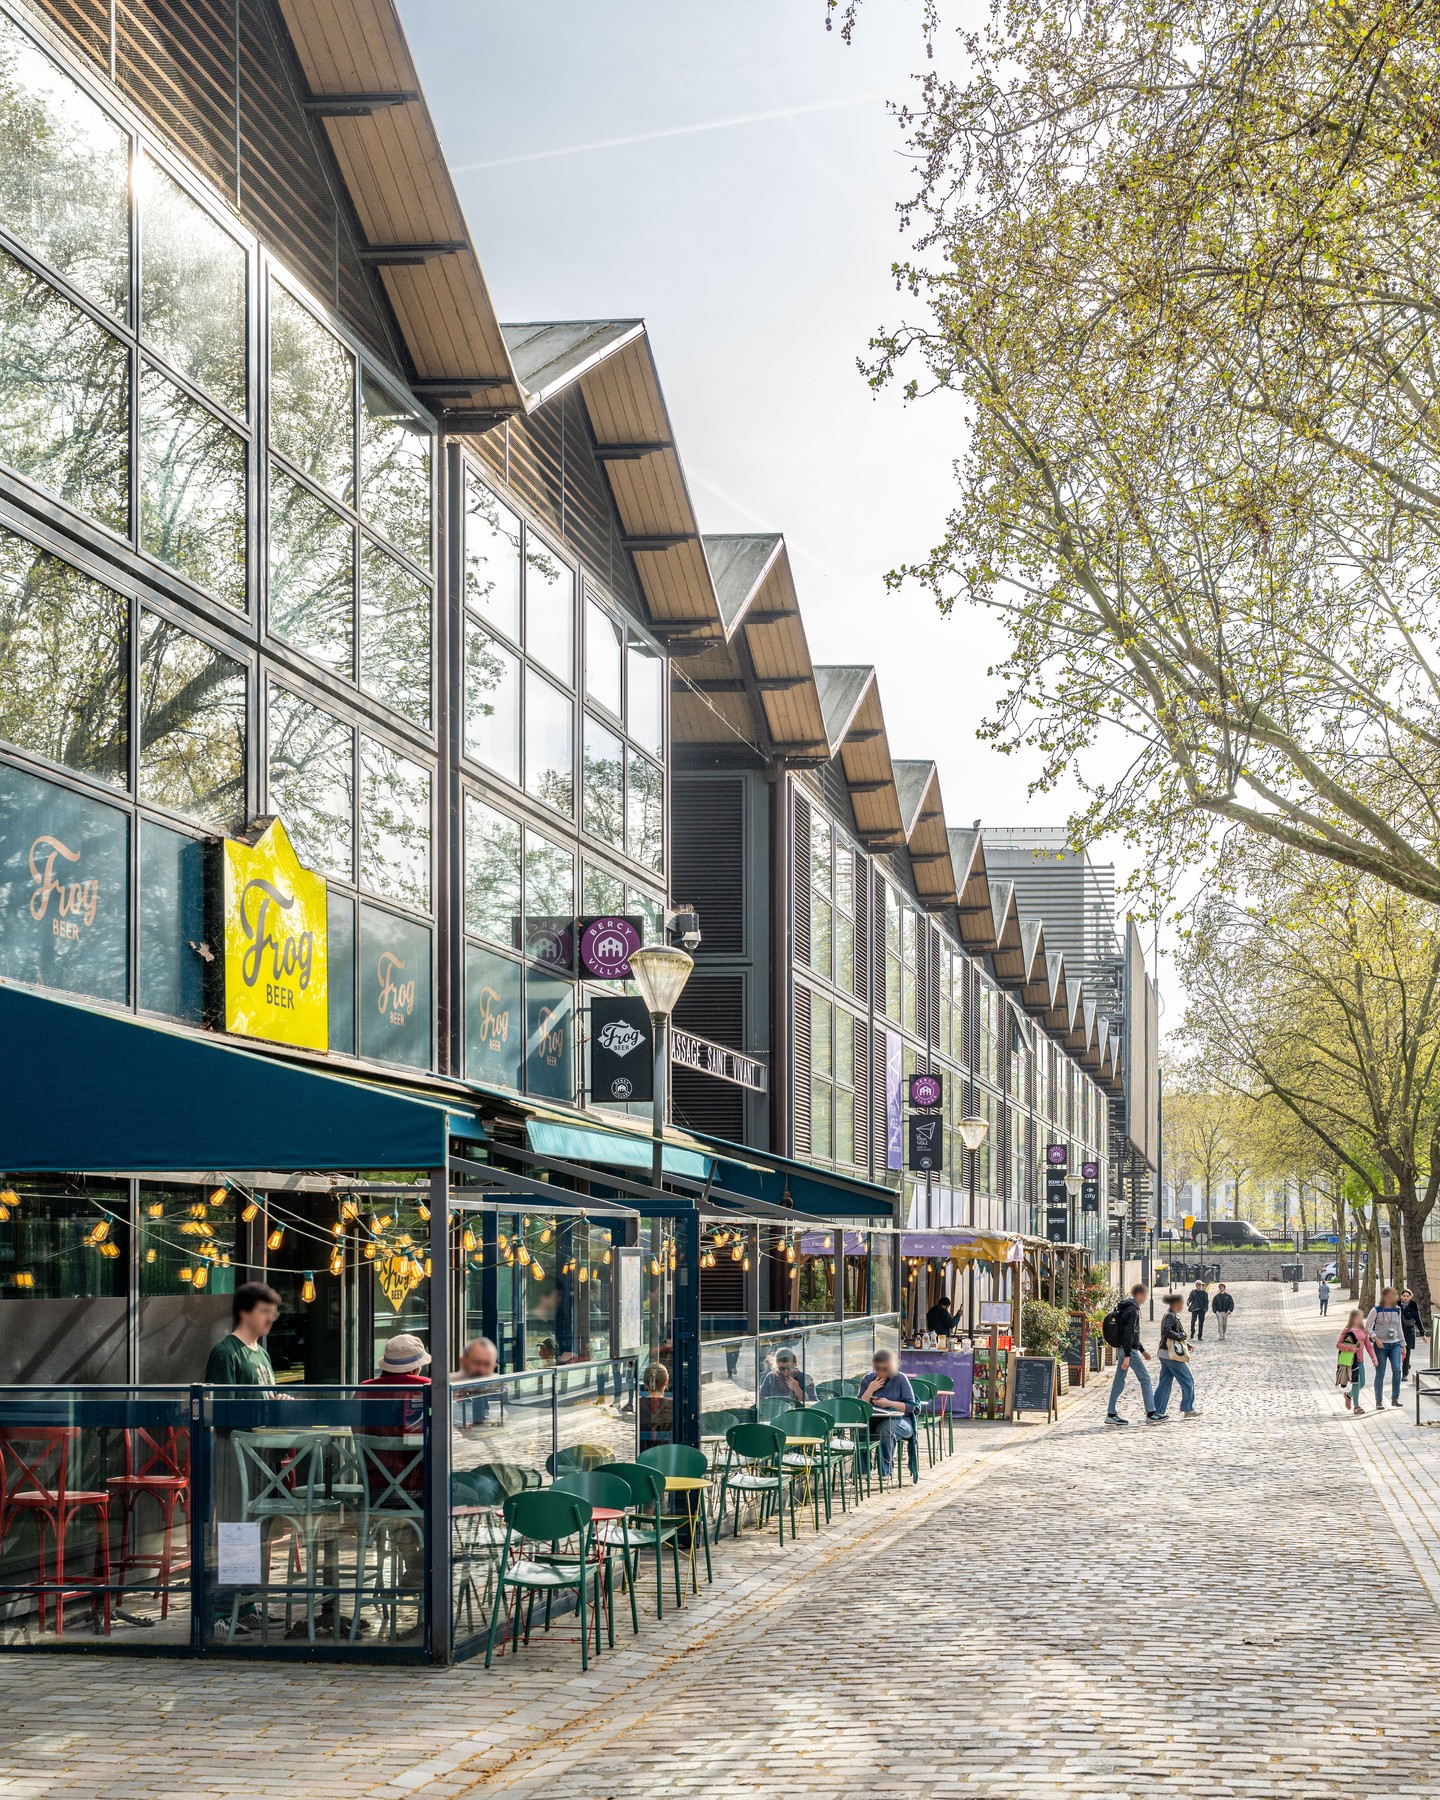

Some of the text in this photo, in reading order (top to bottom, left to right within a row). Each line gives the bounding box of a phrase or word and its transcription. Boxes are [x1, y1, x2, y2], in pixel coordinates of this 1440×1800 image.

[29, 835, 99, 927] Frog
[52, 918, 80, 942] BEER
[240, 878, 313, 990] Frog
[590, 921, 632, 936] BERCY
[588, 958, 628, 975] VILLAG
[377, 951, 415, 1016] Frog
[266, 983, 295, 1010] BEER
[389, 1011, 405, 1027] BEER
[480, 986, 509, 1042] Frog
[538, 1006, 564, 1058] Frog
[602, 1022, 640, 1047] Frog
[490, 1039, 501, 1052] BEER
[547, 1055, 557, 1067] BEER
[671, 1032, 755, 1087] ASSAGE SAINT VIVANT
[915, 1078, 936, 1086] BERCY
[391, 1289, 403, 1300] BEER
